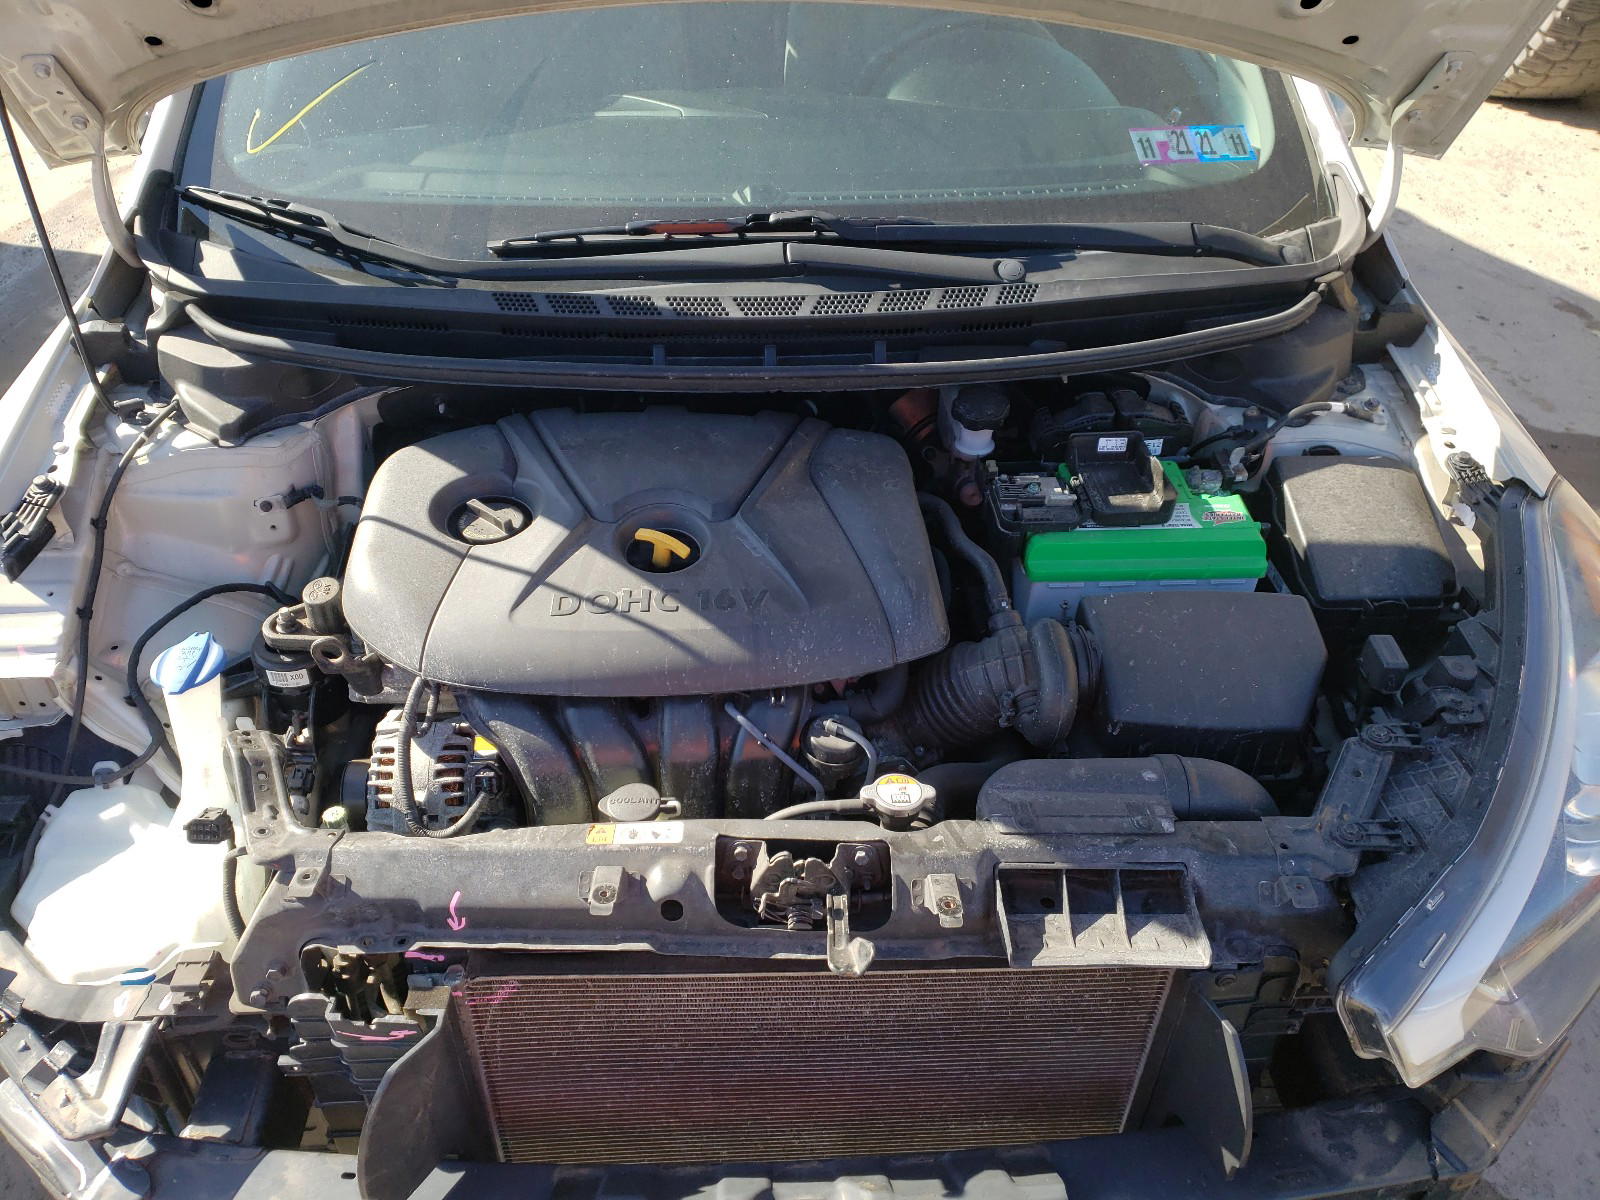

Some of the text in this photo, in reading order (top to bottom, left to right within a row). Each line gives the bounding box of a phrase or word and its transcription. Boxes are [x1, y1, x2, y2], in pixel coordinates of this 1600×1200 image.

[1137, 129, 1193, 158] 11 21
[1195, 130, 1218, 154] 21
[550, 588, 770, 617] DOHC 16V
[610, 796, 660, 805] COOLANT
